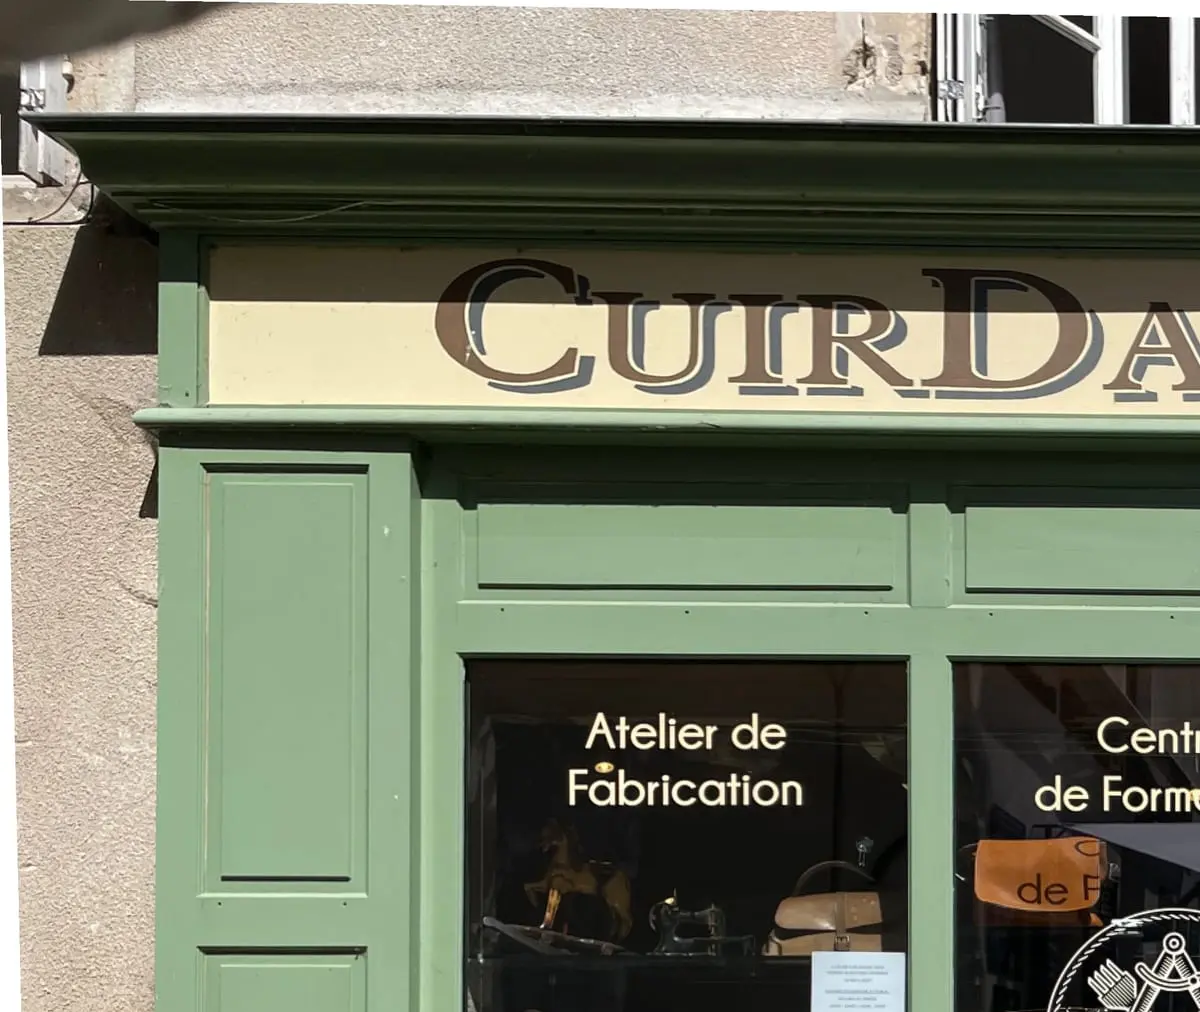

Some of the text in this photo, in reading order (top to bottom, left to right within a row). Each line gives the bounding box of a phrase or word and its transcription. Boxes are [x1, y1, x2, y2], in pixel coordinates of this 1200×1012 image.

[586, 712, 787, 750] Atelier de
[568, 769, 803, 806] Fabrication
[1034, 775, 1089, 812] de
